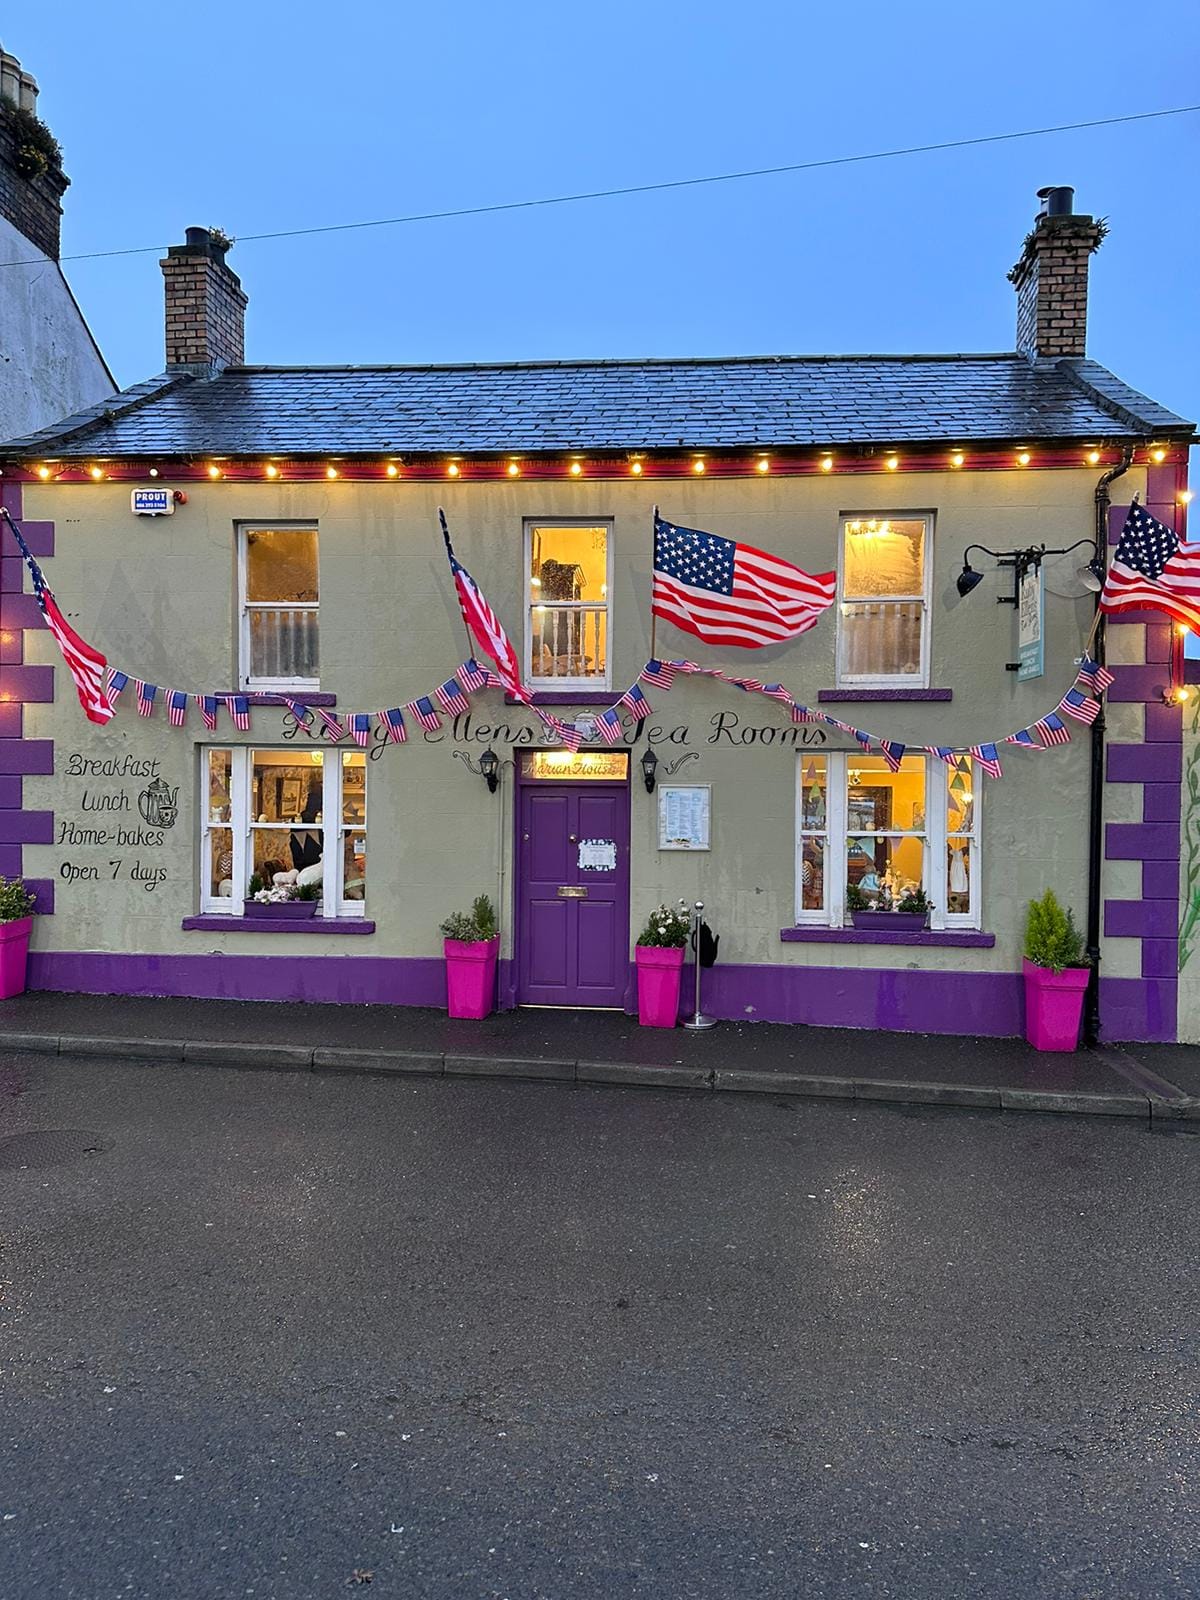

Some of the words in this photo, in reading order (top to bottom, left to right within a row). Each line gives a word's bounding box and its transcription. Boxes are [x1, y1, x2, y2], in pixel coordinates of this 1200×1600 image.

[136, 493, 166, 501] PROUT
[622, 709, 691, 745] Tea
[707, 711, 827, 746] Rooms
[65, 753, 161, 778] Breakfast
[57, 821, 165, 846] Home-bakes
[60, 862, 100, 885] Open
[109, 860, 122, 880] 7
[130, 860, 168, 892] days
